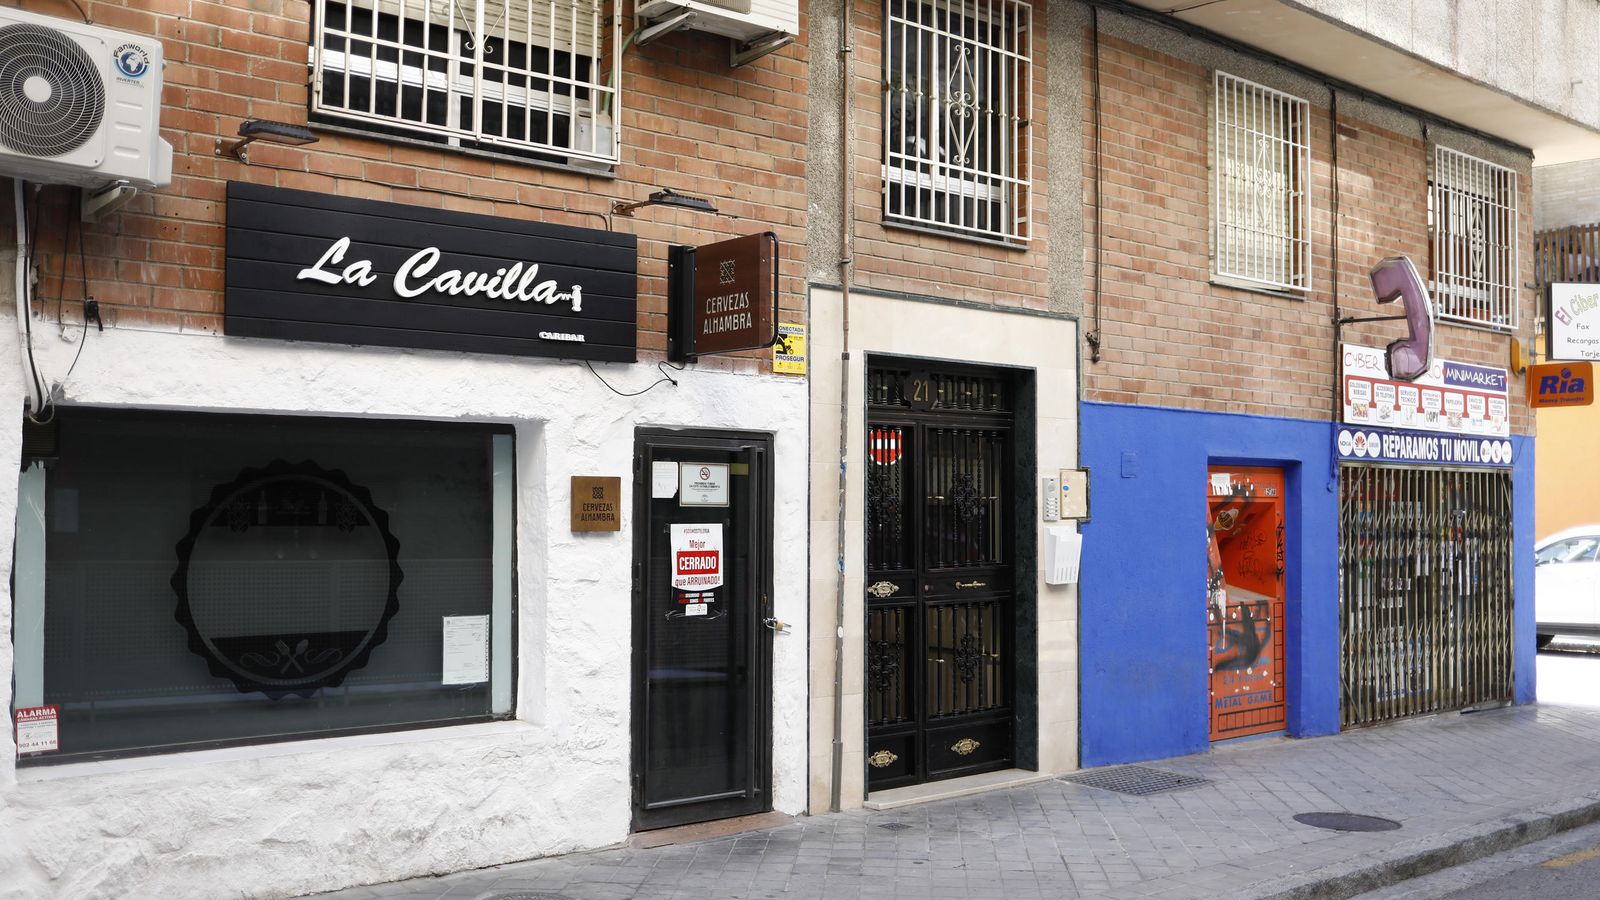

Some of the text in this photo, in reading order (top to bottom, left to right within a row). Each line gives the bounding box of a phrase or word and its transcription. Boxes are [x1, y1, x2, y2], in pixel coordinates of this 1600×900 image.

[113, 43, 150, 65] Fanworld
[296, 236, 560, 304] La Cavilla
[706, 291, 750, 314] CERVEZAS
[1555, 292, 1599, 326] El Ciber
[703, 312, 753, 335] ALHAMBRA
[778, 325, 804, 333] ONECTADA
[539, 331, 586, 342] CARIBAR
[1567, 337, 1600, 346] Recargas
[775, 354, 805, 363] PROSEGUR
[1345, 352, 1381, 371] CYBER
[1446, 367, 1505, 387] MINIMARKET
[1539, 368, 1585, 395] Ria
[913, 380, 929, 401] 21
[1426, 409, 1439, 424] COPY
[1382, 434, 1480, 462] REPARAMOS TU MOVIL
[582, 502, 613, 512] CERVEZAS
[580, 512, 615, 522] ALHAMBRA
[689, 539, 706, 550] Mejor
[679, 556, 716, 570] CERRADO
[675, 575, 720, 587] que ARRUINADO!
[17, 708, 57, 718] ALARMA
